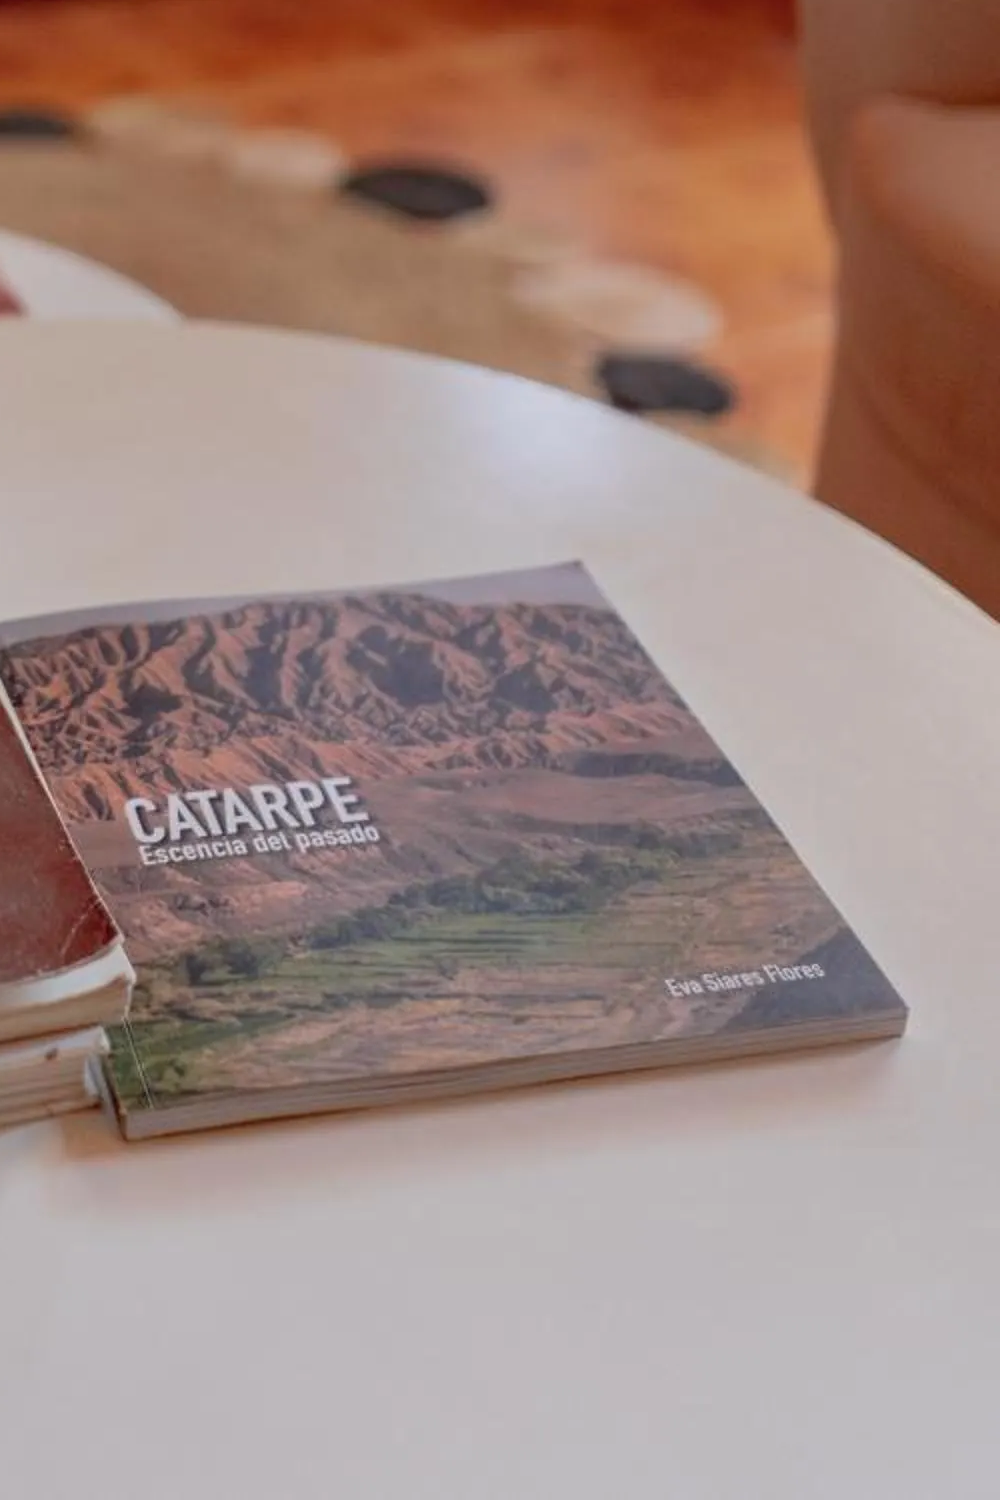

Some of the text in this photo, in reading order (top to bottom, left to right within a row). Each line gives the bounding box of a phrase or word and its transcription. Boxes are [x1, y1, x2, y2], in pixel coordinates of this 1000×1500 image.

[123, 775, 370, 845] CATARPE
[138, 822, 382, 866] Escencia del pasado
[664, 962, 827, 999] Eva Siares Flores
